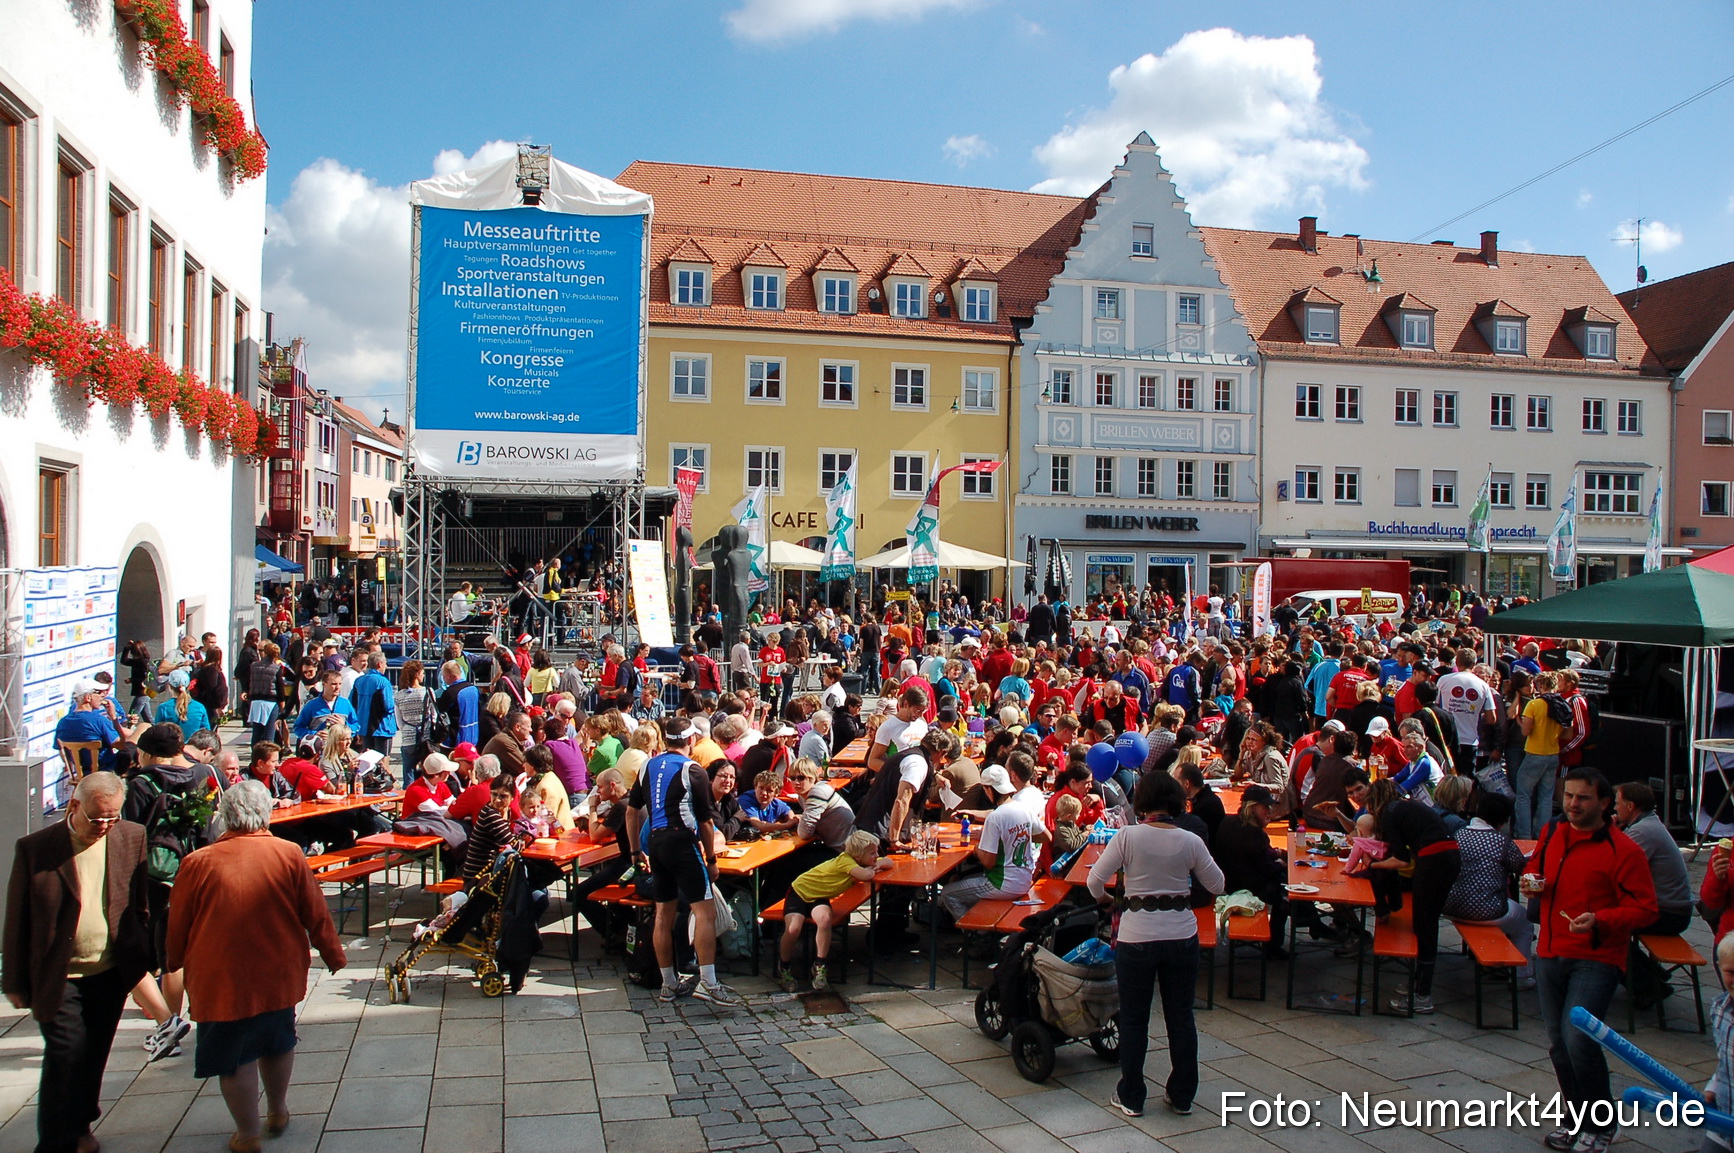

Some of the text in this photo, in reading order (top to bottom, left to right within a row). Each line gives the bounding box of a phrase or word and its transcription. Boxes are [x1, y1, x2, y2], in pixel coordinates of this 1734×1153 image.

[463, 220, 601, 243] Messeauftritte
[443, 238, 570, 255] Hauptversammlungen
[572, 247, 617, 256] Get together
[463, 255, 498, 264] Tagungen
[500, 254, 586, 270] Roadshows
[457, 267, 605, 288] Sportveranstaltungen
[441, 281, 559, 300] Installationen
[561, 292, 619, 301] TV-Produktionen
[454, 300, 566, 314] Kulturveranstaltungen
[460, 322, 594, 340] Firmeneröffnungen
[530, 346, 574, 354] Firmenfeiern
[480, 350, 565, 370] Kongresse
[523, 368, 559, 377] Musicals
[487, 375, 551, 388] Konzerte
[503, 388, 542, 396] Tourservice
[474, 410, 581, 422] www.barowski-ag.de
[1100, 424, 1194, 441] BRILLEN WEBER
[486, 446, 597, 461] BAROWSKI AG
[1278, 483, 1287, 499] R
[362, 515, 370, 523] B
[771, 511, 818, 528] CAFE
[1085, 514, 1201, 532] BRILLEN WEBER
[1368, 520, 1537, 539] Buchhandlung pprecht
[1257, 571, 1265, 613] KLEBL
[1363, 595, 1370, 606] A
